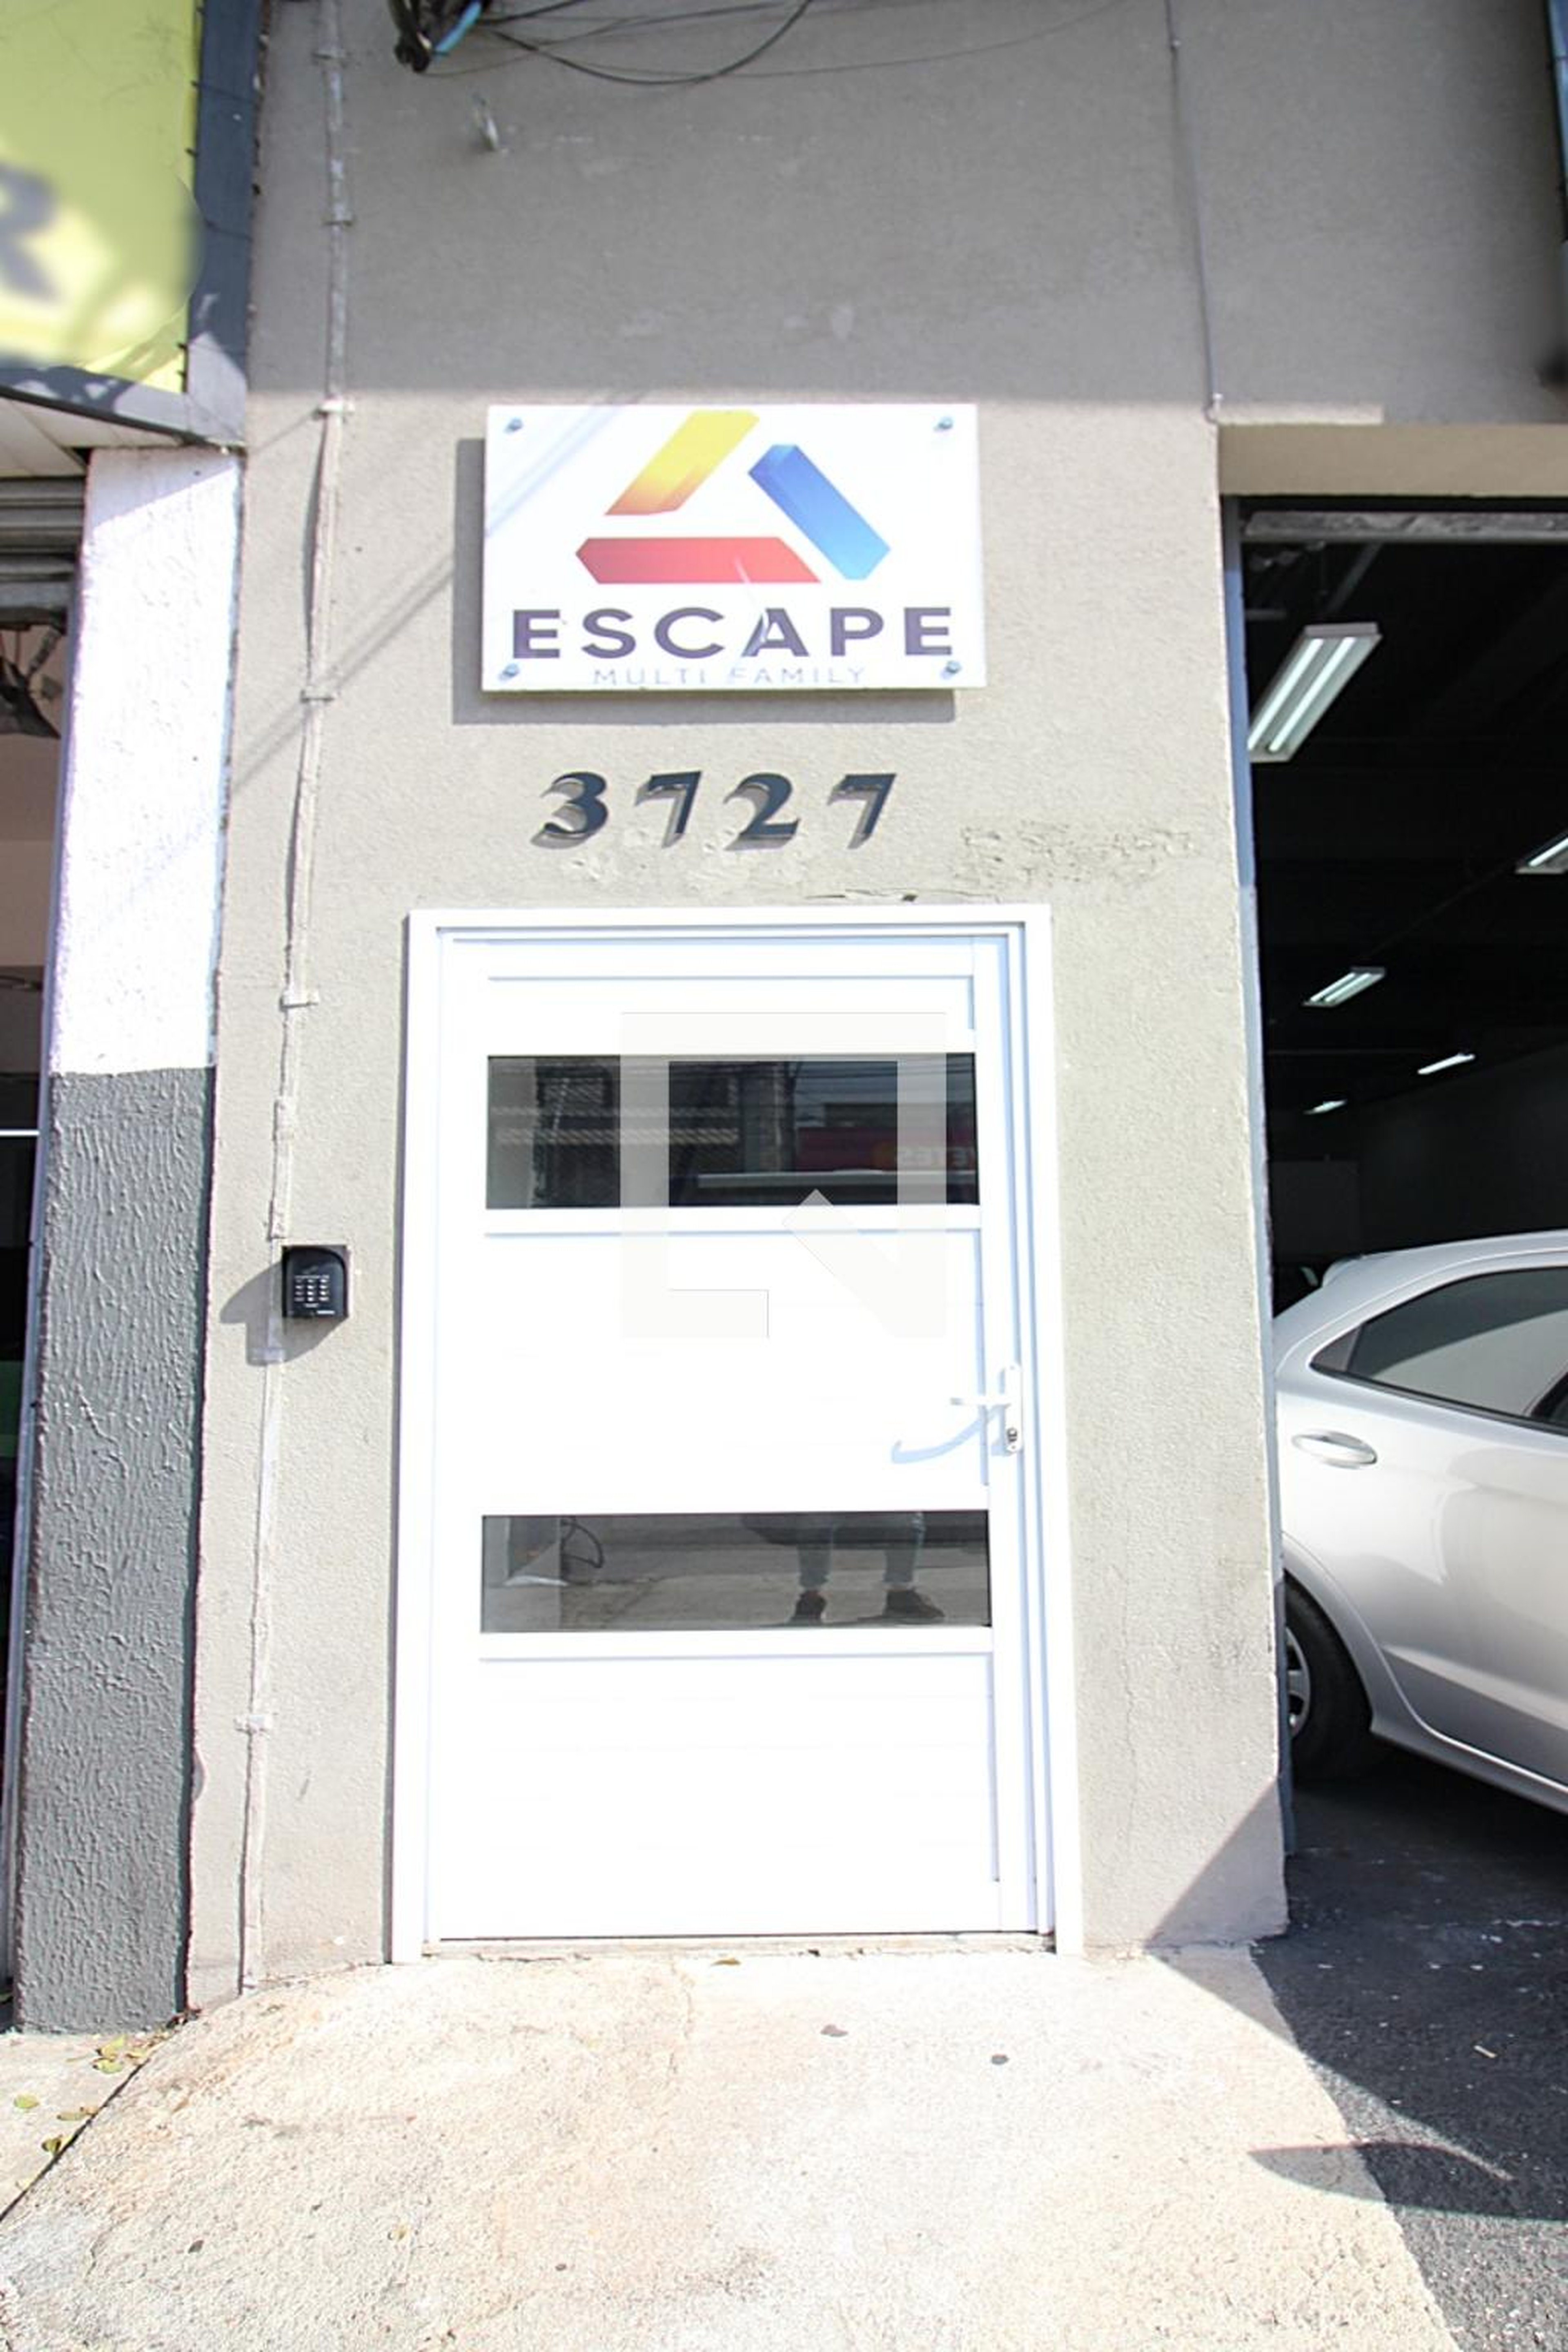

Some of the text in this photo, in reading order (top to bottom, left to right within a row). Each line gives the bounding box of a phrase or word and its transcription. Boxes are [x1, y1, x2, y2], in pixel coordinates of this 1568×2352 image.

[512, 607, 953, 659] ESCAPE
[592, 666, 866, 685] MULTI FAMILY
[541, 770, 897, 841] 3727
